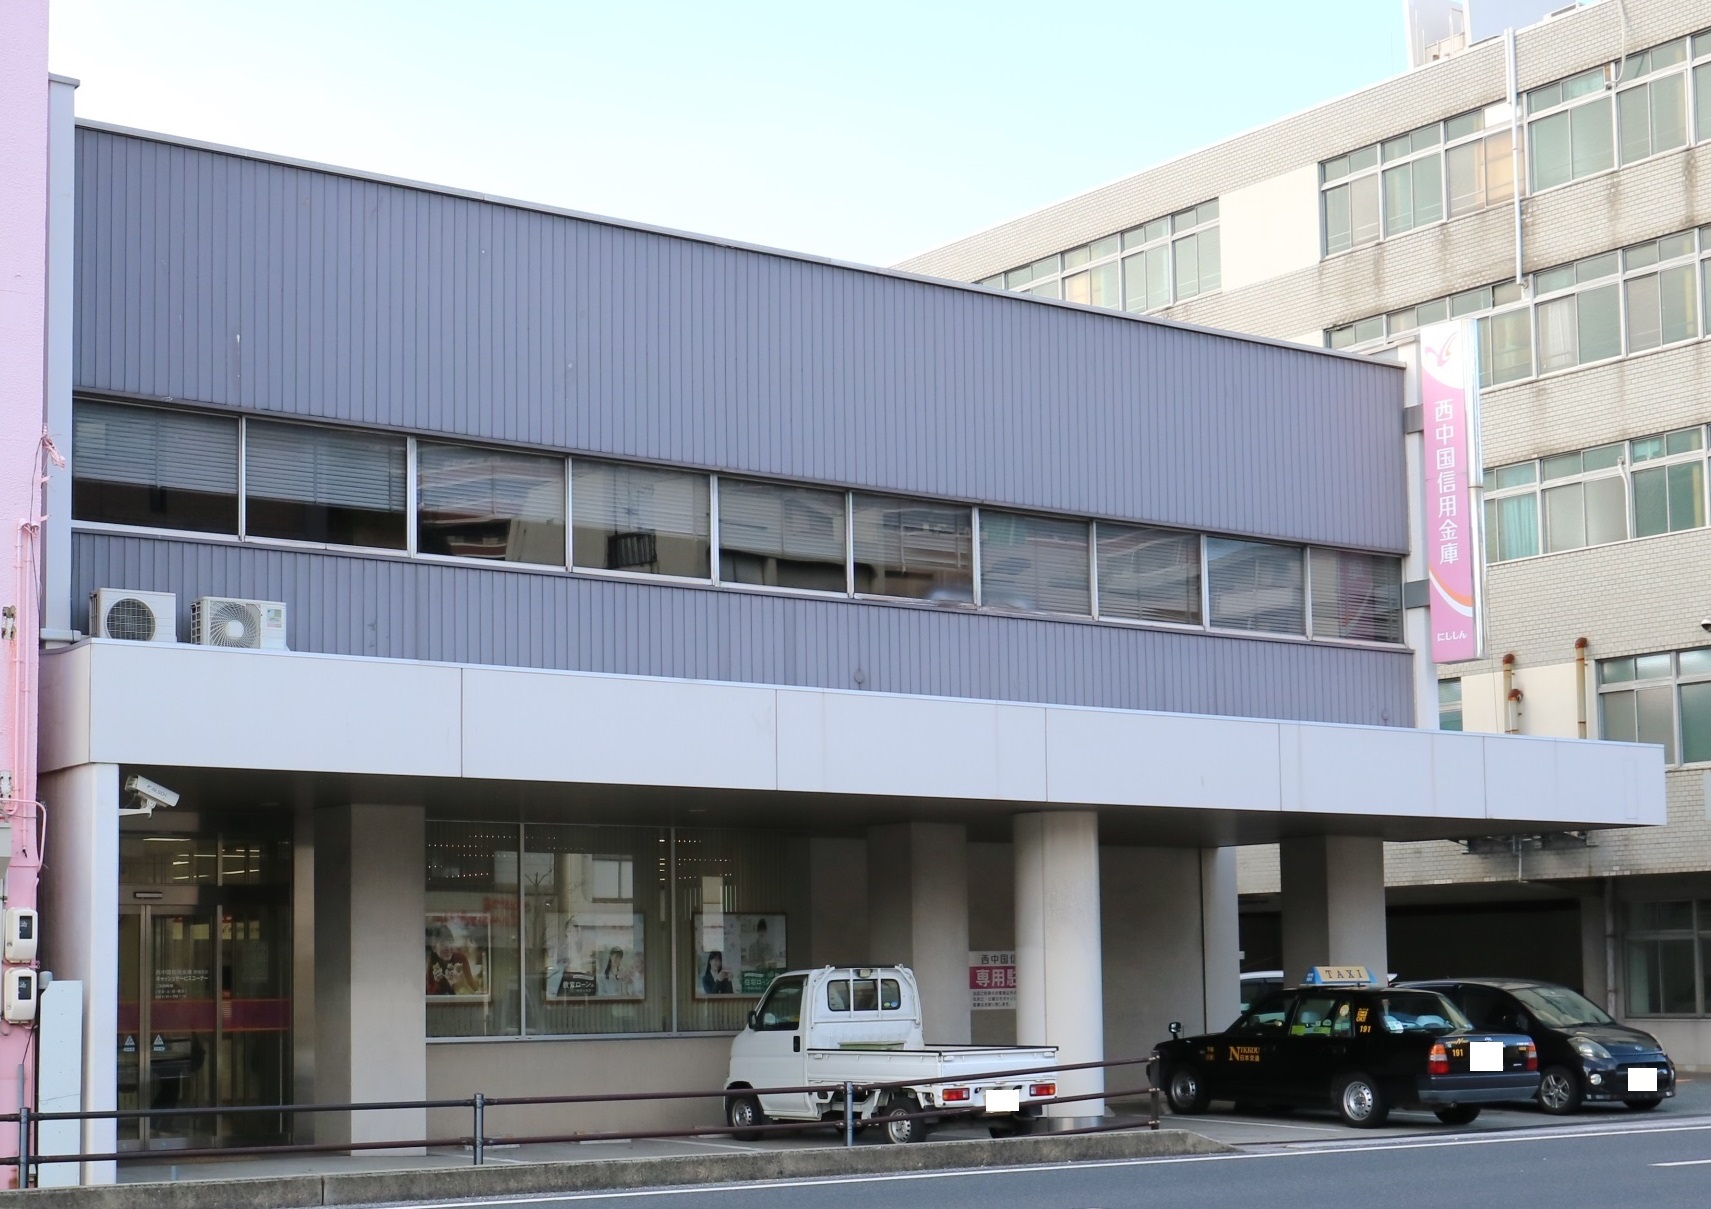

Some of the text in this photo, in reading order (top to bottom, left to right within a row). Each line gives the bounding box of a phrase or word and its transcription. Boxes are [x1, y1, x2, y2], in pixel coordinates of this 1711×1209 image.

[1434, 398, 1459, 565] 西中国信用金庫
[1437, 630, 1468, 642] にししん
[1325, 969, 1364, 979] TAXI
[1359, 1025, 1371, 1033] 191
[1452, 1049, 1464, 1057] 191
